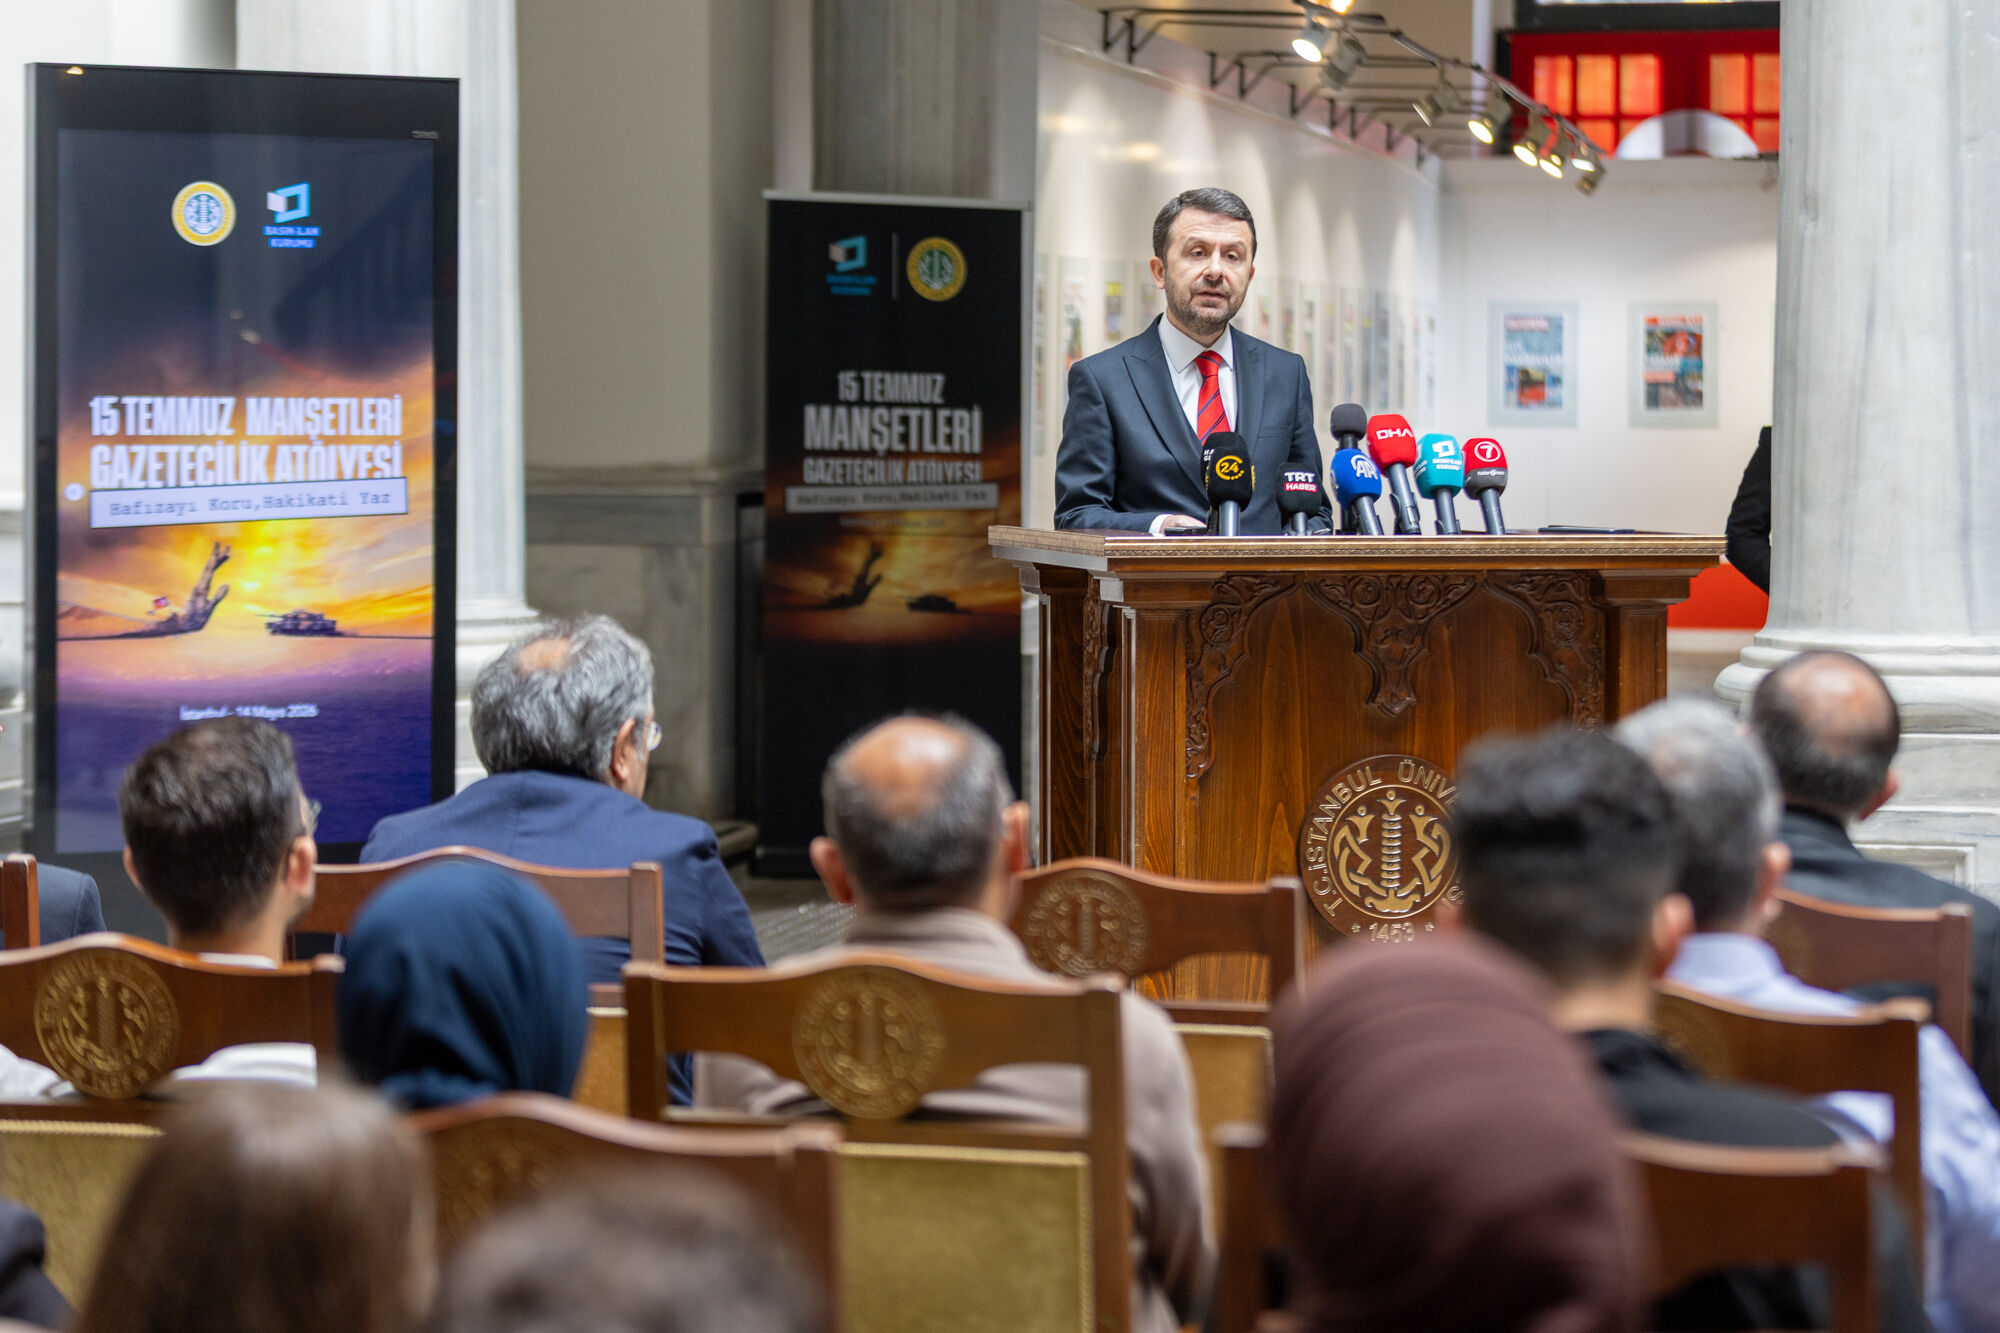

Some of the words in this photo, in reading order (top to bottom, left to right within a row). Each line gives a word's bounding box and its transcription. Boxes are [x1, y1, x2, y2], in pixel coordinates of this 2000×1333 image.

[838, 371, 859, 401] 15
[861, 371, 945, 404] TEMMUZ
[88, 395, 120, 436] 15
[121, 396, 236, 436] TEMMUZ
[245, 393, 403, 440] MANŞETLERİ
[803, 404, 983, 457] MANŞETLERİ
[1376, 428, 1413, 440] DHA
[90, 440, 270, 489] GAZETECİLİK
[1479, 444, 1493, 459] 7
[803, 456, 905, 485] GAZETECİLİK
[1284, 471, 1316, 483] TRT
[1285, 483, 1317, 492] HABER
[109, 500, 197, 517] Hafızayı
[360, 492, 391, 505] Yaz
[1306, 766, 1383, 871] İSTANBUL
[1369, 922, 1416, 943] 1453
